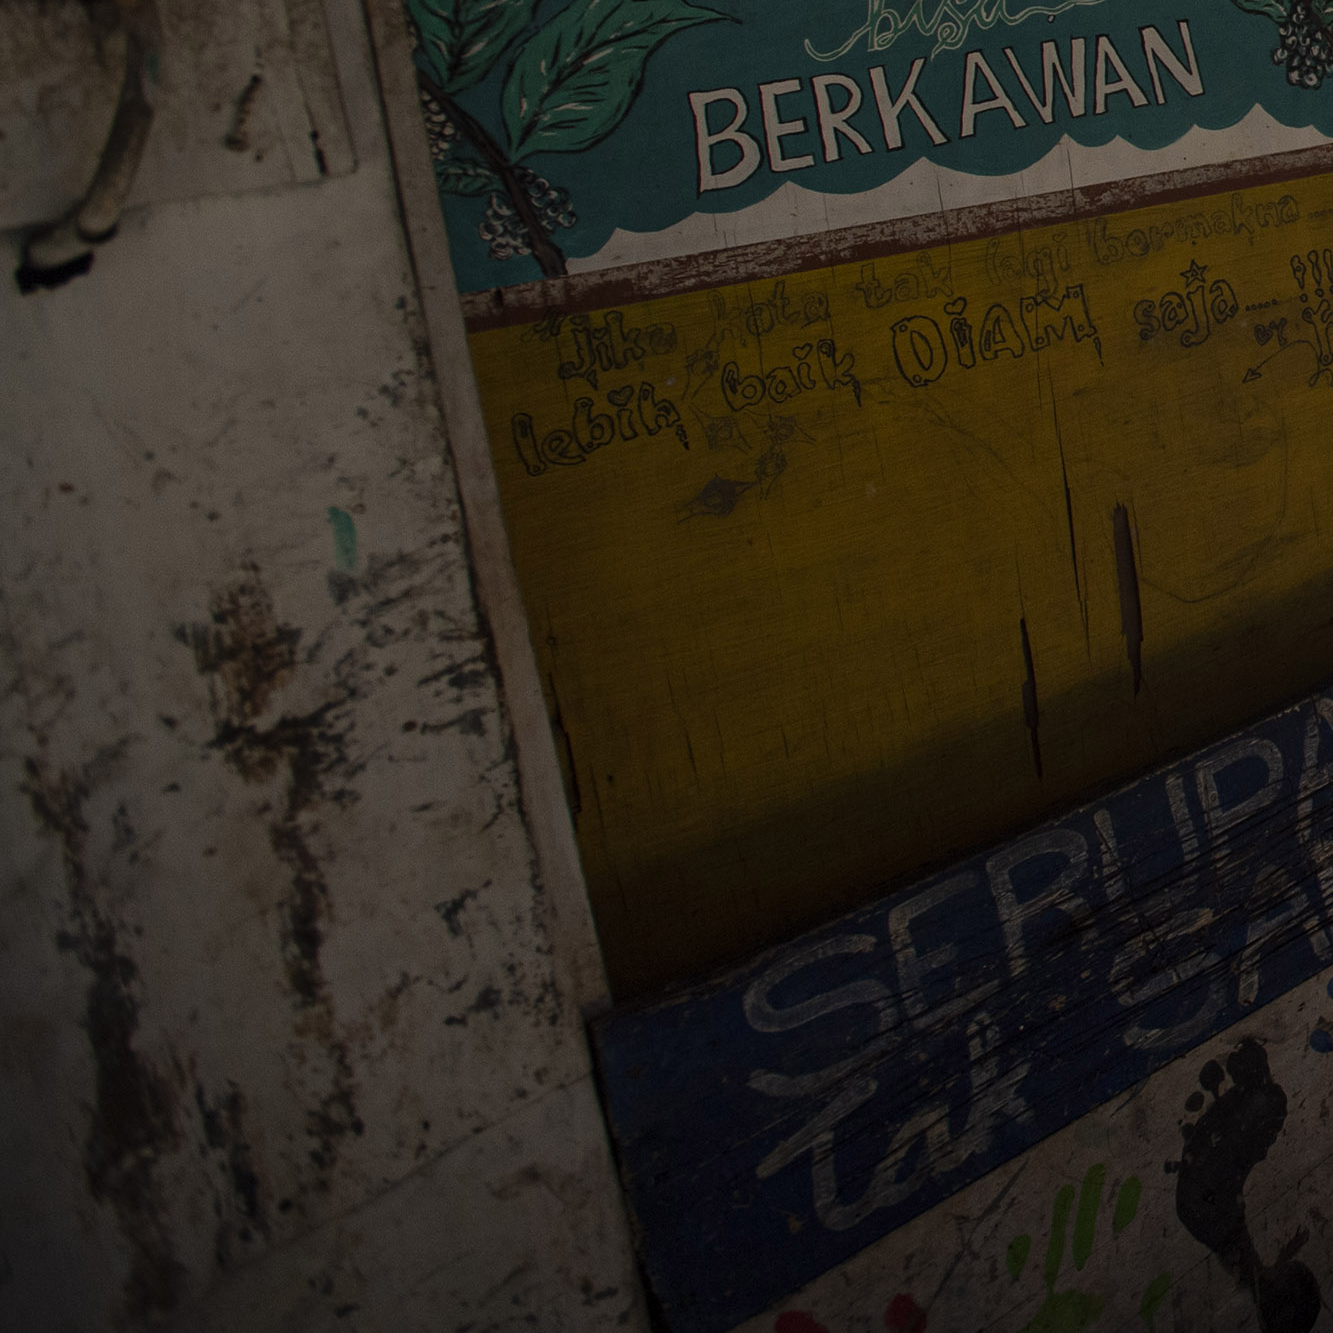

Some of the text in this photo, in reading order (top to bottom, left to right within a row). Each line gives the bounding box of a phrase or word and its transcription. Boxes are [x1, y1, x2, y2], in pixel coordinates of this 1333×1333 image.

[688, 19, 1206, 198] BERKAWAN
[511, 382, 683, 477] lebih
[721, 338, 859, 412] baik
